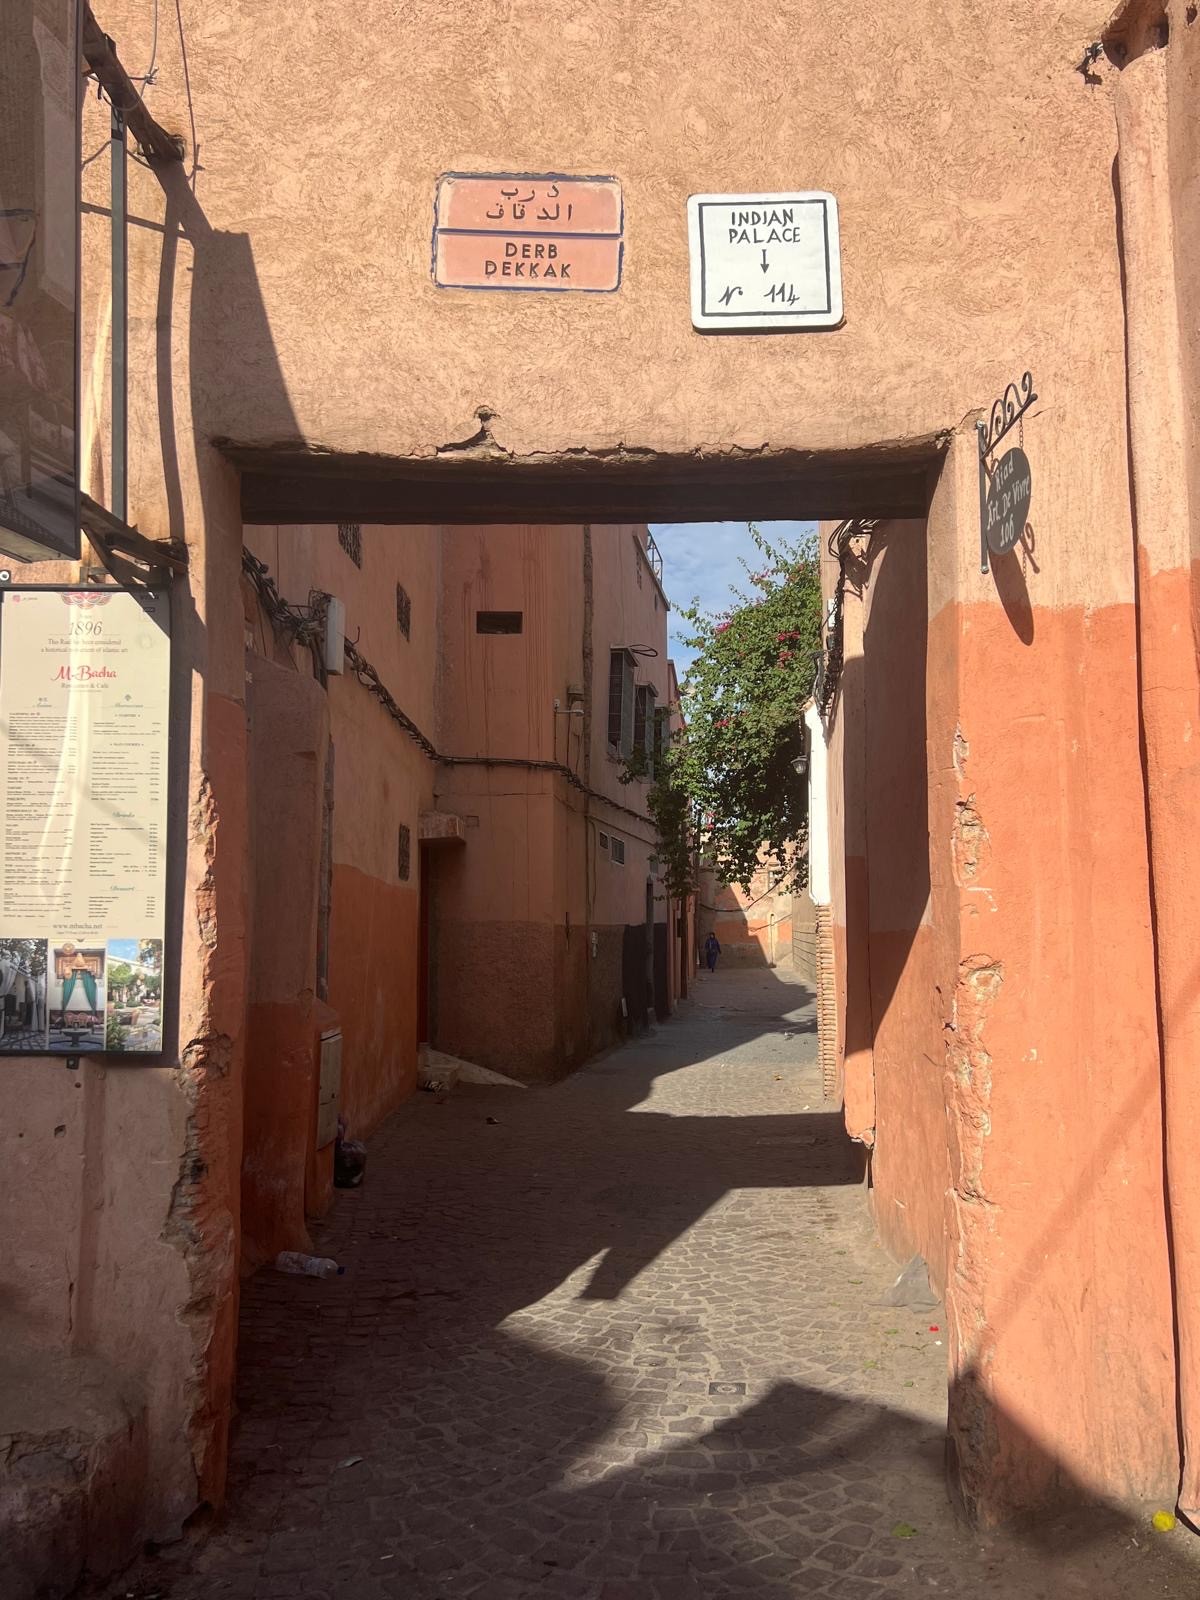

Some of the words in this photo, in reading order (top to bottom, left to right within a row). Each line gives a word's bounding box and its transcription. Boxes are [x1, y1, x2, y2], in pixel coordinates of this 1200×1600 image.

[500, 184, 560, 203] درب
[731, 208, 794, 228] INDIAN
[728, 226, 801, 244] PALACE
[505, 242, 558, 259] DERB
[484, 260, 571, 278] DEKKAK
[763, 282, 801, 306] 114
[994, 450, 1014, 492] Riad
[986, 499, 1001, 531] Art
[1002, 490, 1012, 518] De
[1011, 474, 1030, 505] Vivre
[1000, 512, 1015, 548] 106
[68, 620, 104, 636] 1896
